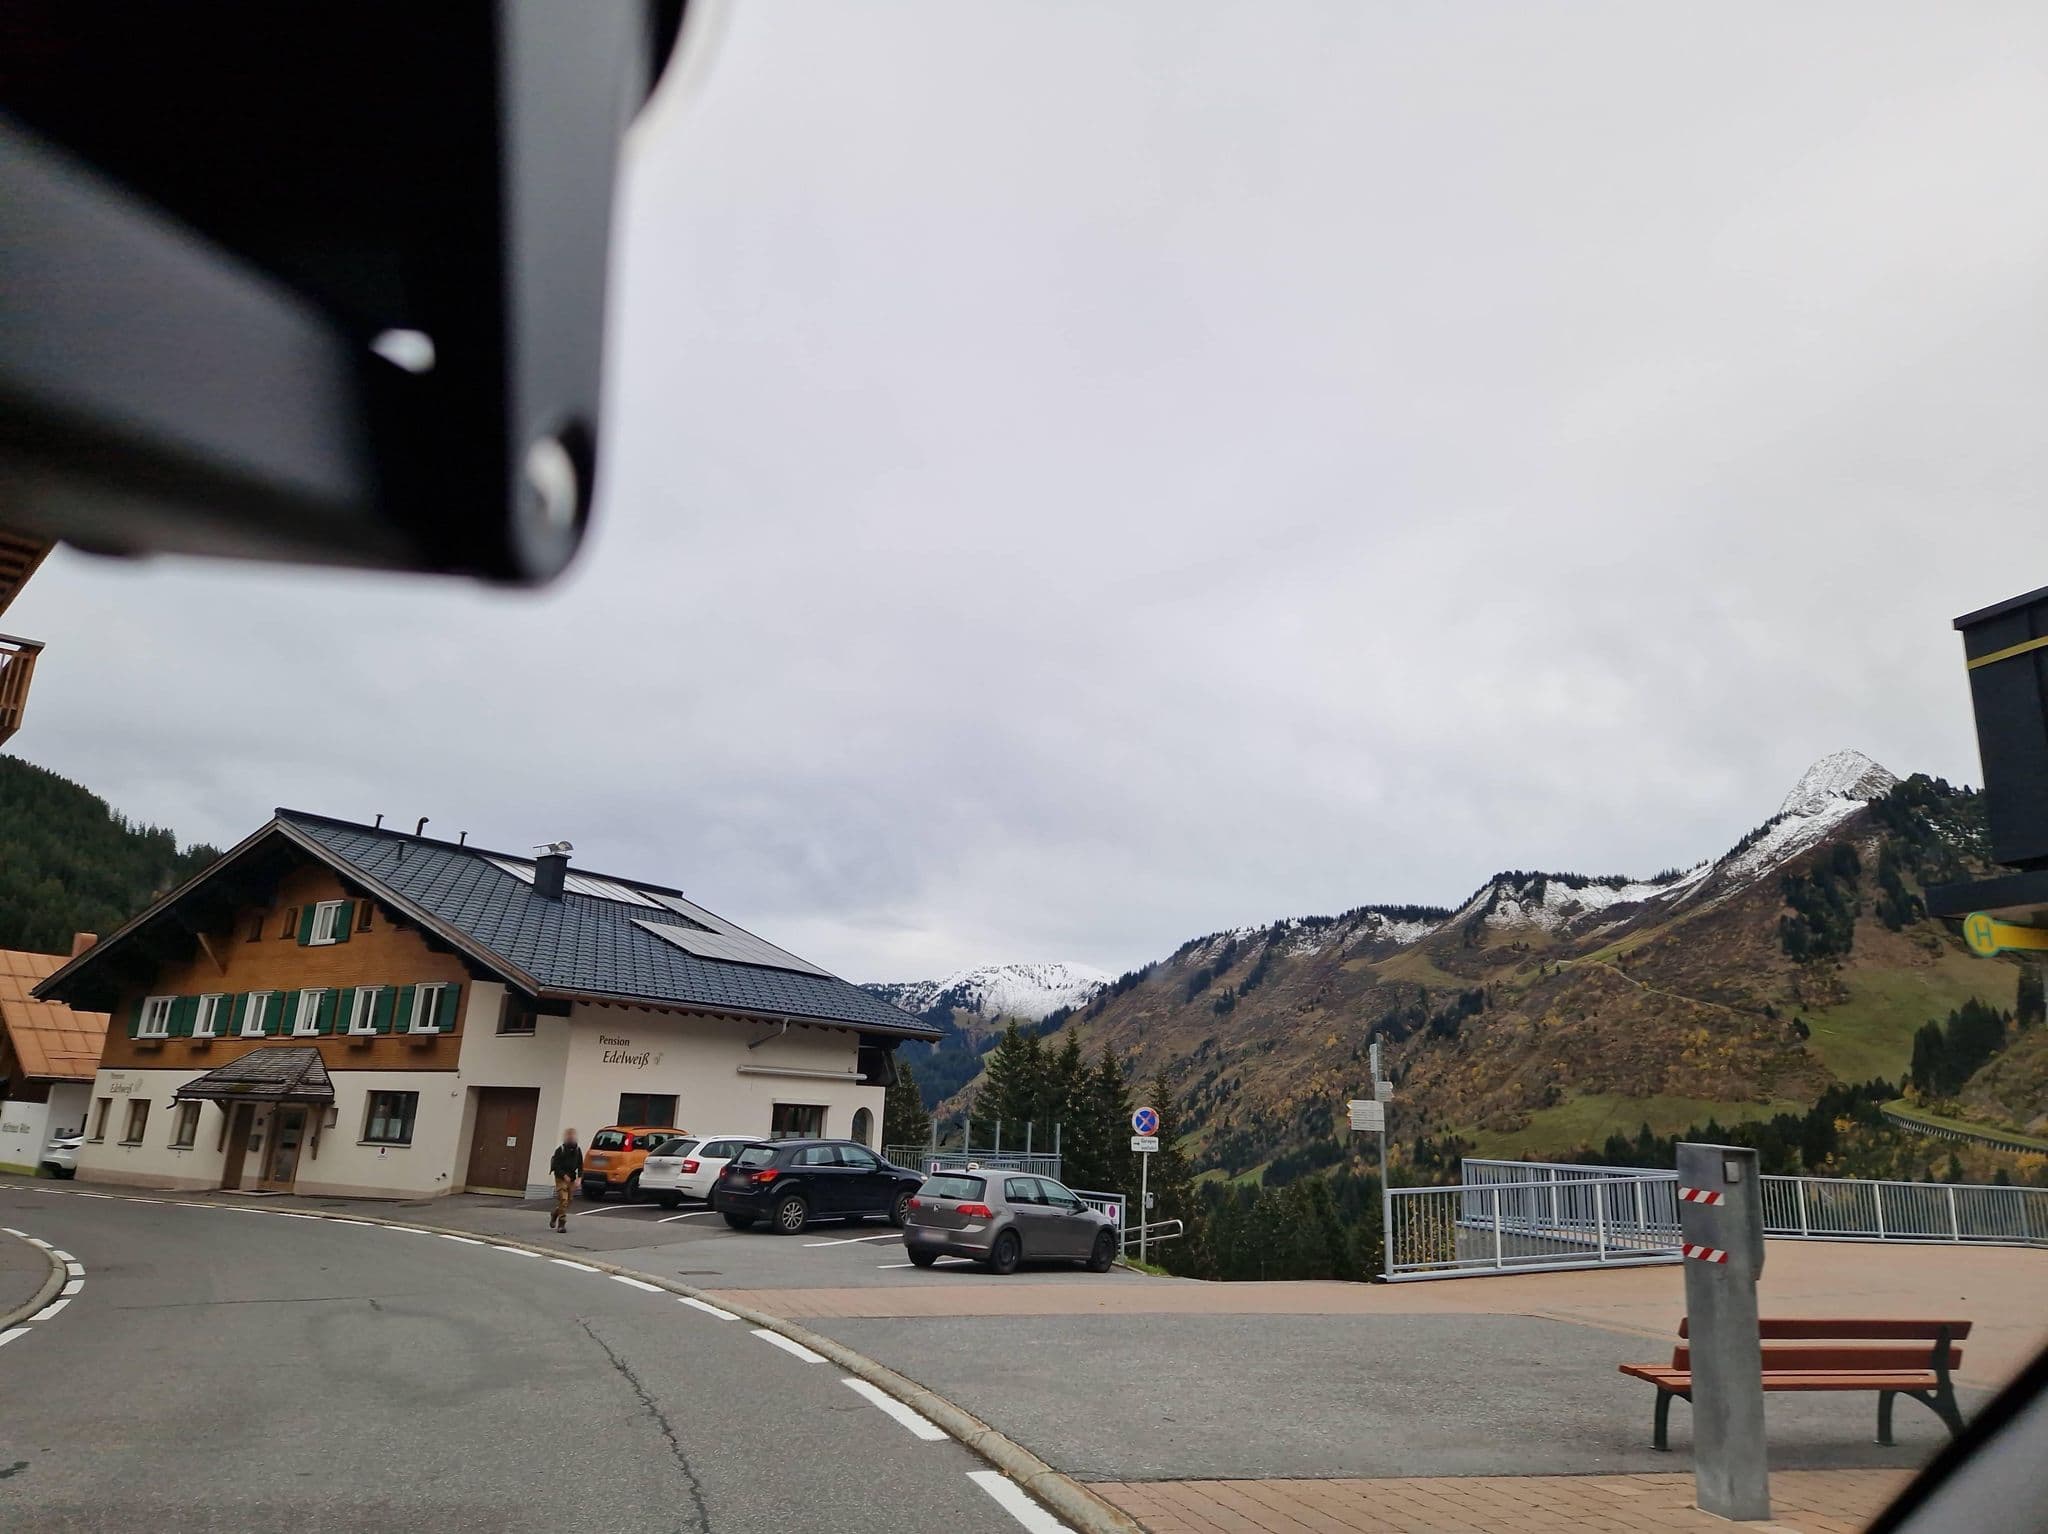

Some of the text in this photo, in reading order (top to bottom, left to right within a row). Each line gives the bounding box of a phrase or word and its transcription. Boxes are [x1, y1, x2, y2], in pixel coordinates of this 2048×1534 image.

[1974, 922, 1994, 948] H
[599, 1034, 630, 1047] Pension
[602, 1050, 650, 1070] Edelweiß
